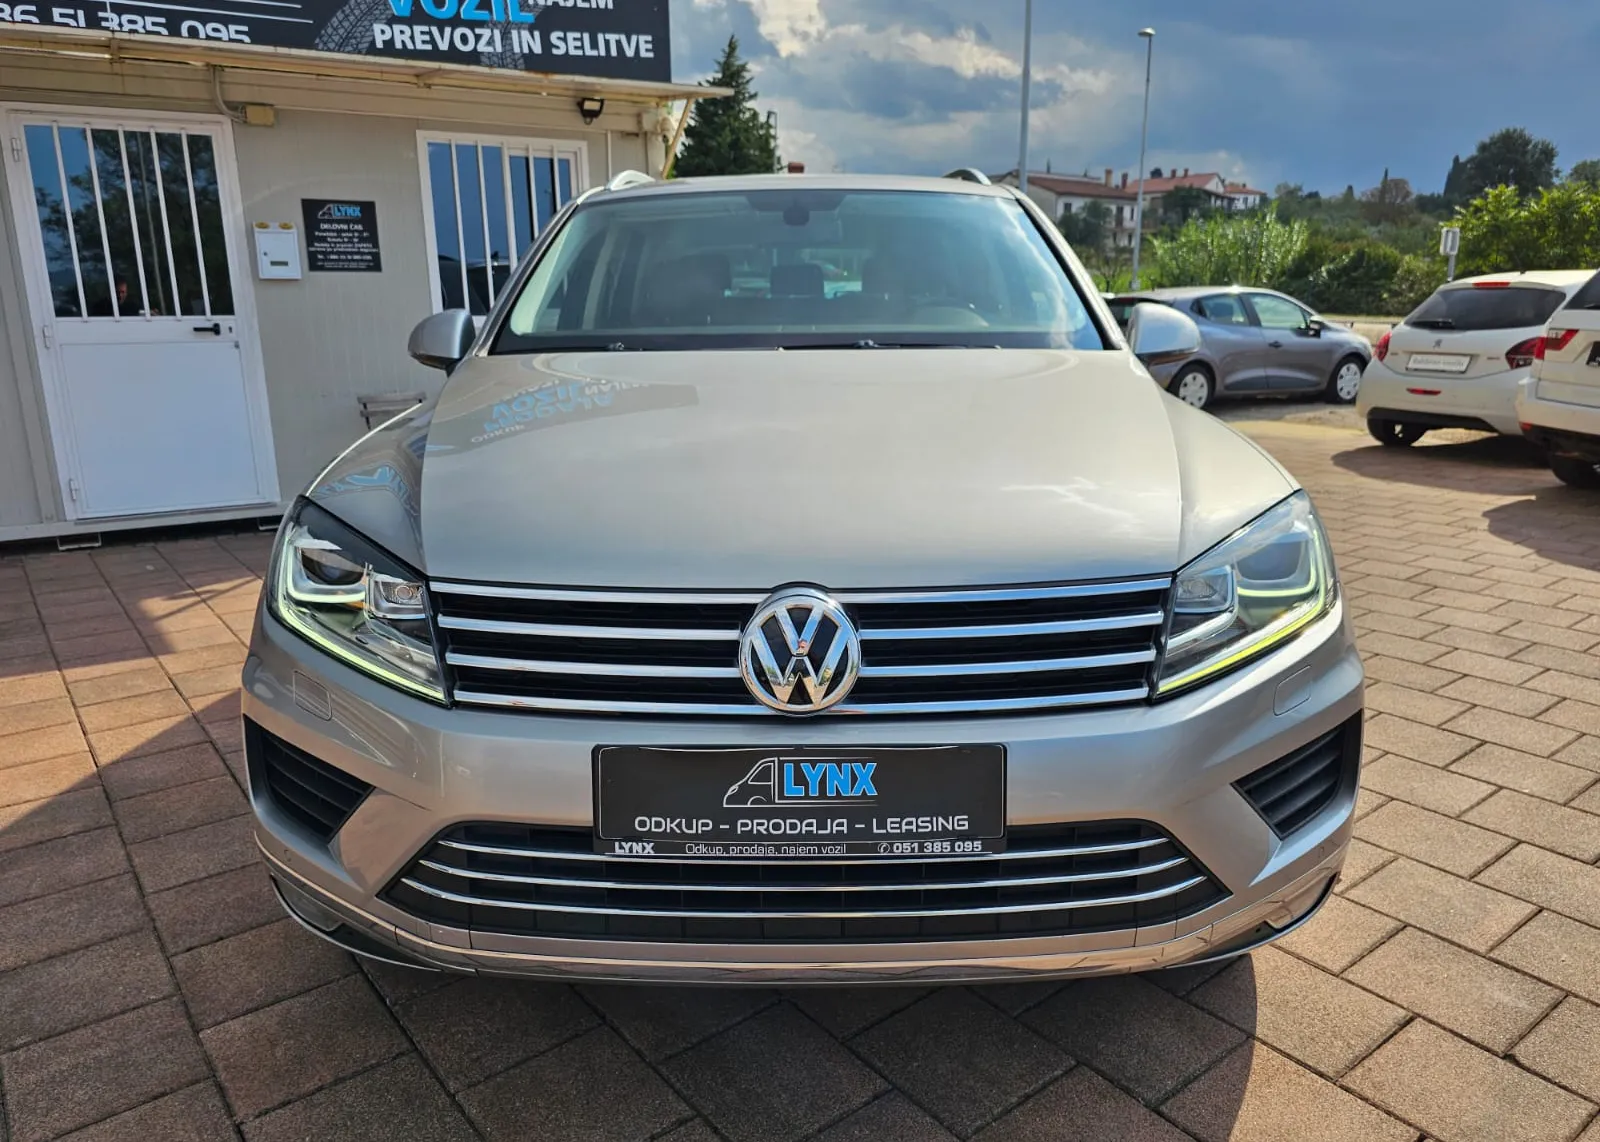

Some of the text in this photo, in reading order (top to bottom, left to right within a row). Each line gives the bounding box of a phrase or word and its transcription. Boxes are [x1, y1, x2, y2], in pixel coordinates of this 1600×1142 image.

[97, 11, 169, 36] 385
[373, 23, 655, 58] PREVOZI IN SELITVE
[334, 206, 361, 217] LYNX
[783, 762, 879, 797] LYNX
[634, 815, 713, 834] ODKUP
[736, 817, 848, 835] PRODAJA
[872, 814, 970, 833] LEASING
[614, 841, 656, 855] LYNX
[685, 843, 847, 857] Odkup, prodaja, najem vozil
[893, 840, 982, 854] 051 385 095
